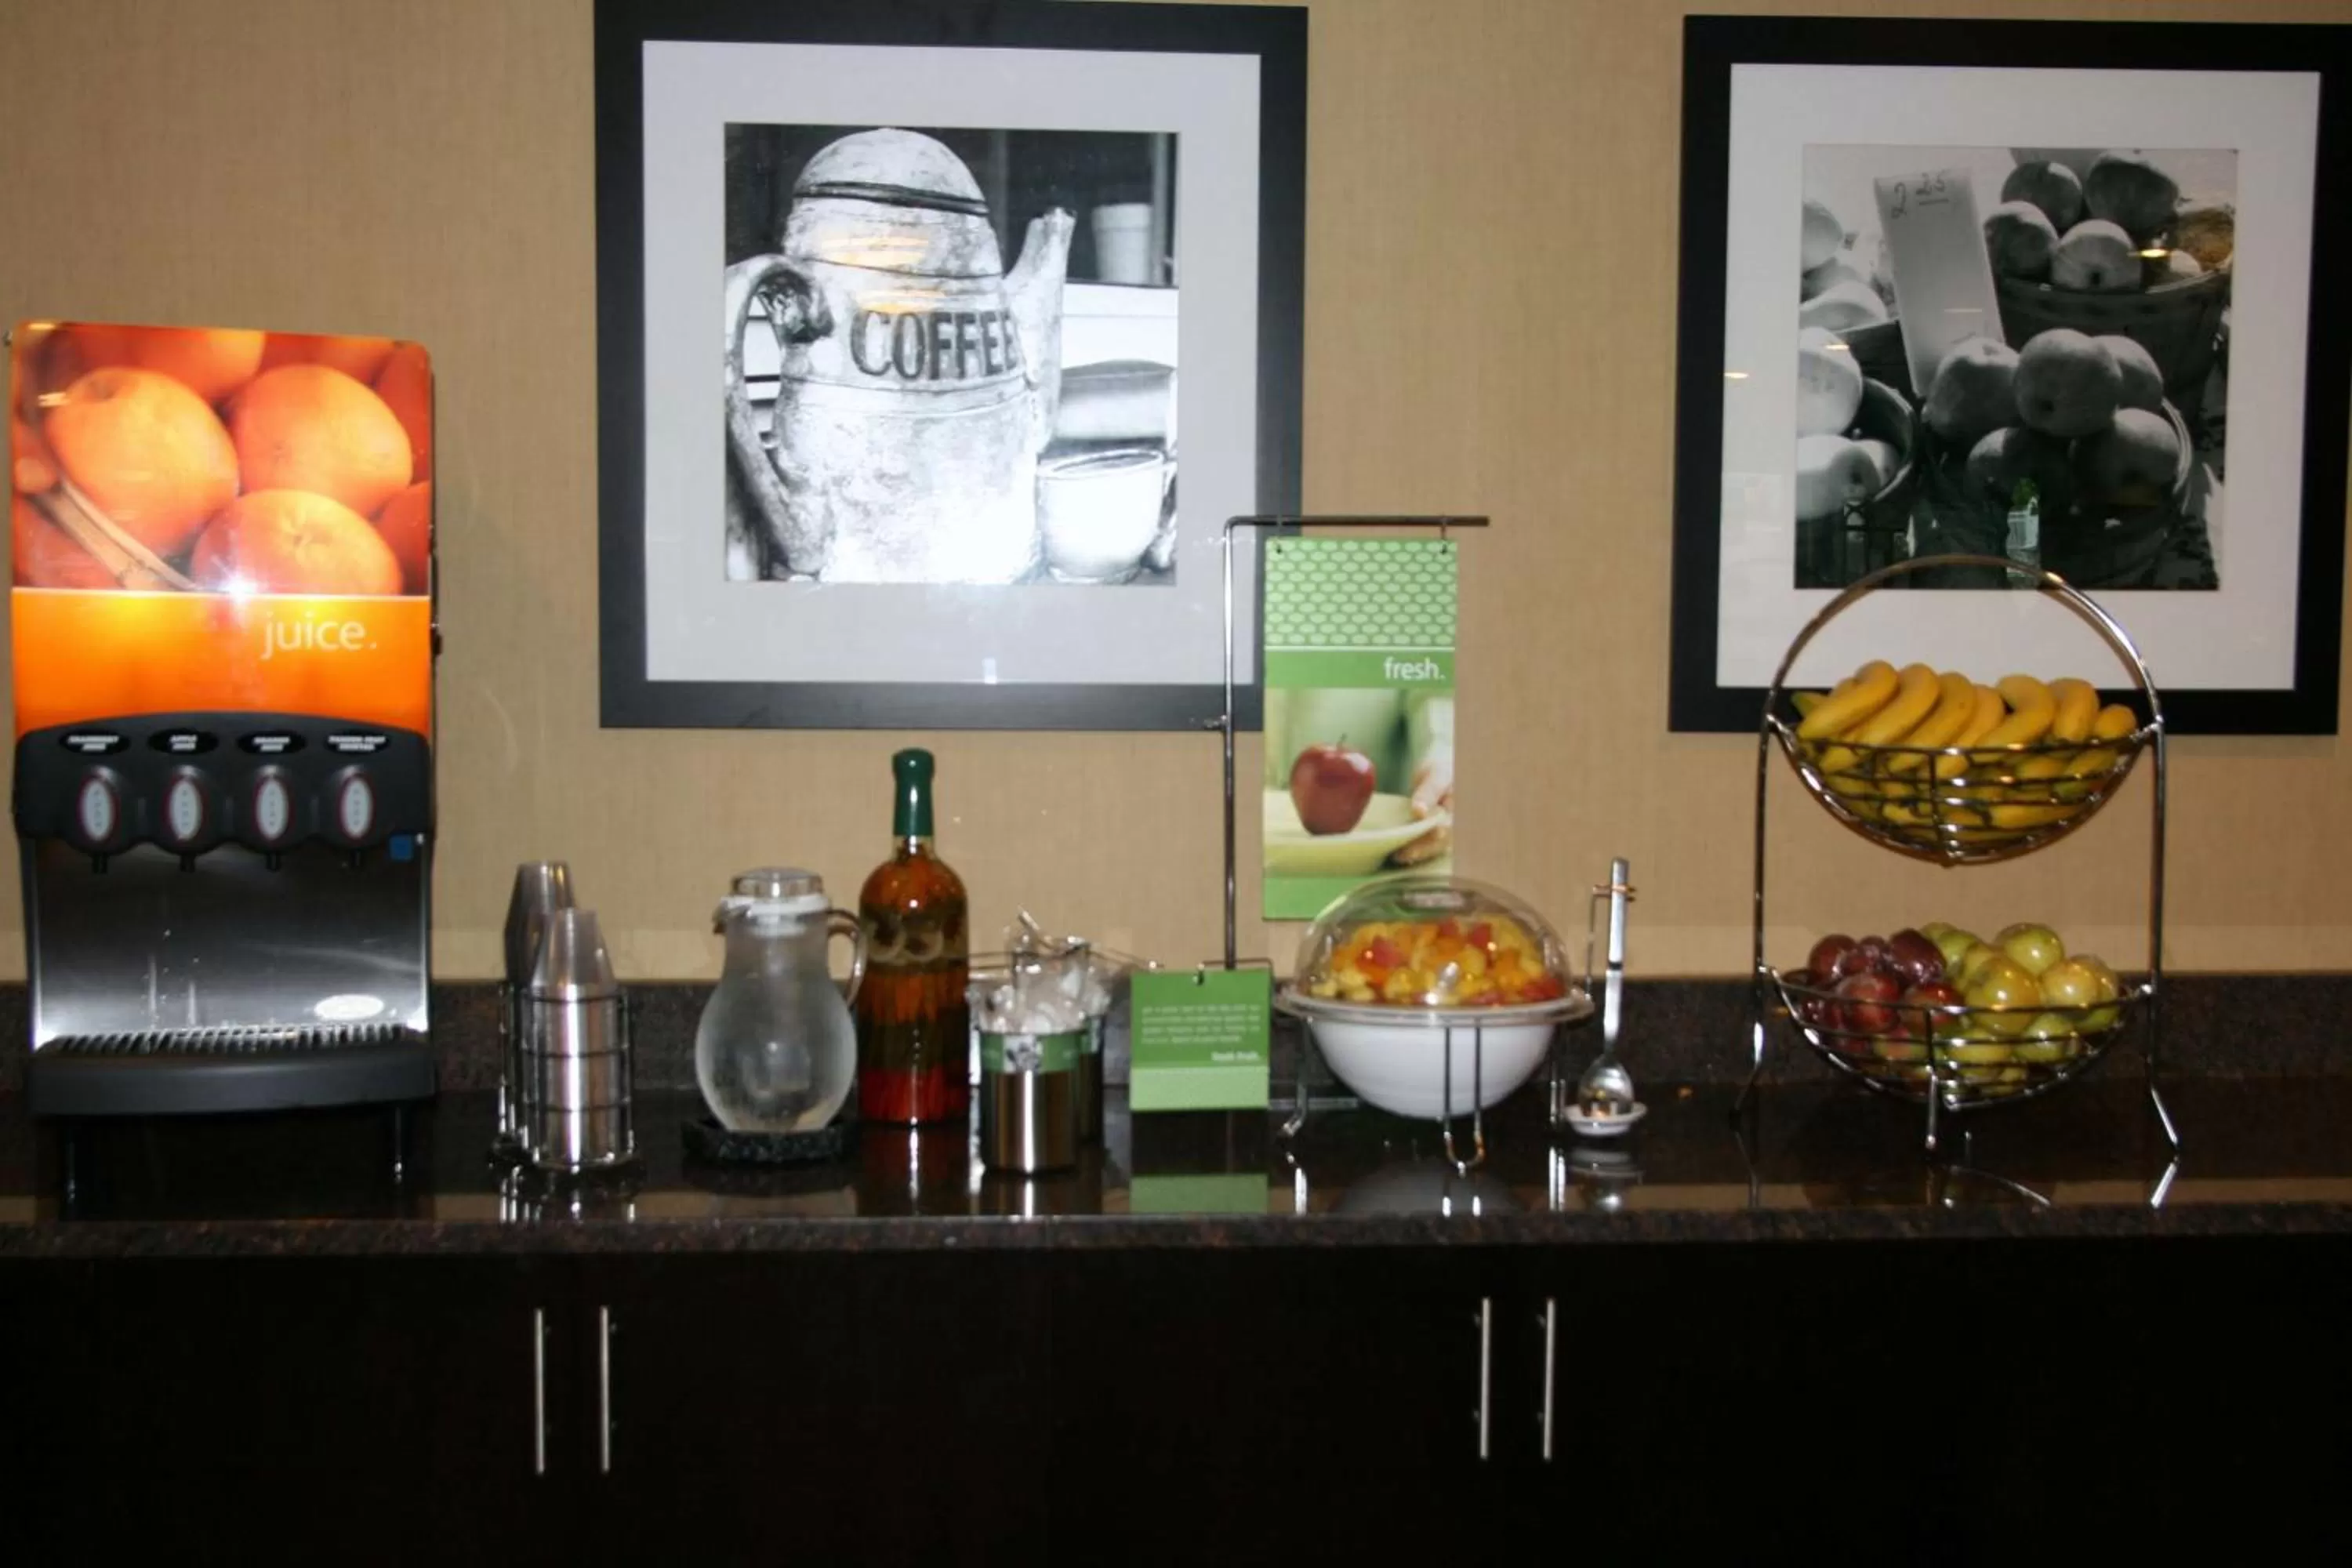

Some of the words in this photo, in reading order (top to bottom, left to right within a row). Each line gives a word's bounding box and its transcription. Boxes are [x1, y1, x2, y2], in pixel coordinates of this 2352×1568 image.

[850, 309, 1018, 380] COFFEE
[260, 611, 377, 662] juice.
[1383, 655, 1446, 681] fresh.
